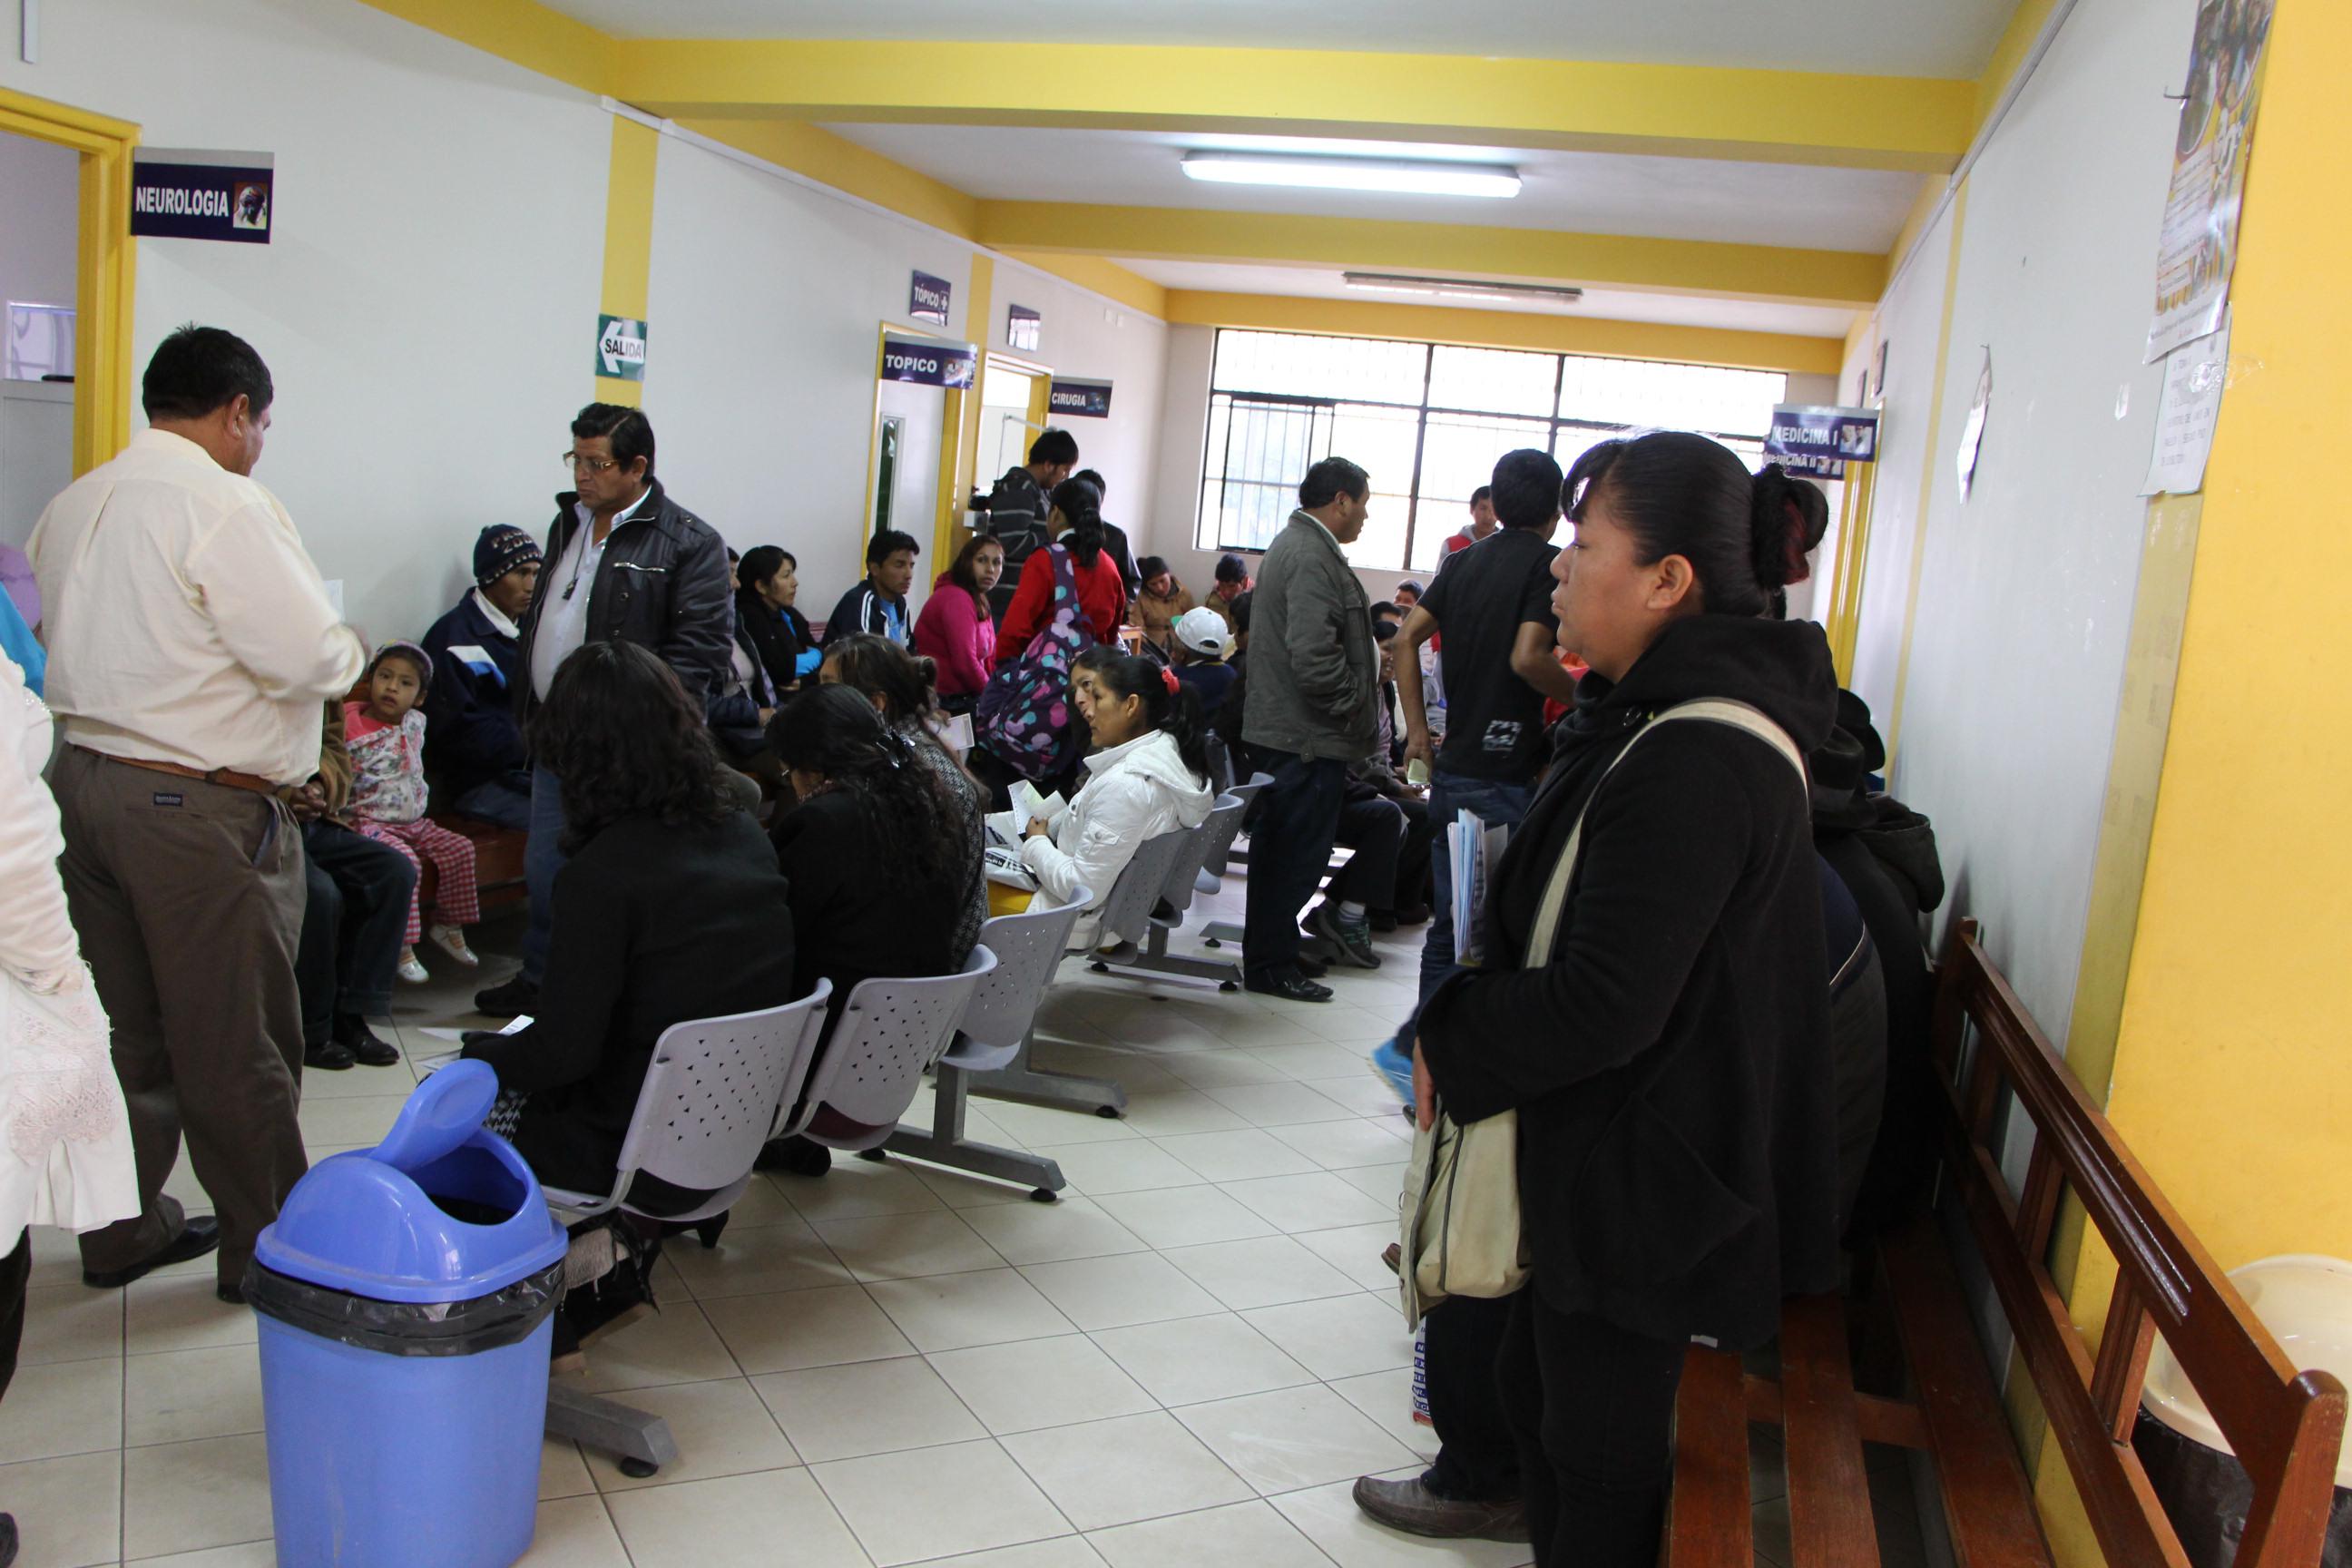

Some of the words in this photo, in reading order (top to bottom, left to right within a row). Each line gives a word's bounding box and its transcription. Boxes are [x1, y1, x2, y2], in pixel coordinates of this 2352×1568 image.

[136, 186, 229, 217] NEUROLOGIA
[915, 283, 939, 308] TÓPICO
[604, 338, 642, 358] SALIDA
[886, 354, 937, 373] TOPICO
[1052, 392, 1086, 407] CIRUGIA
[1771, 426, 1830, 445] MEDICINA
[1833, 430, 1838, 446] I
